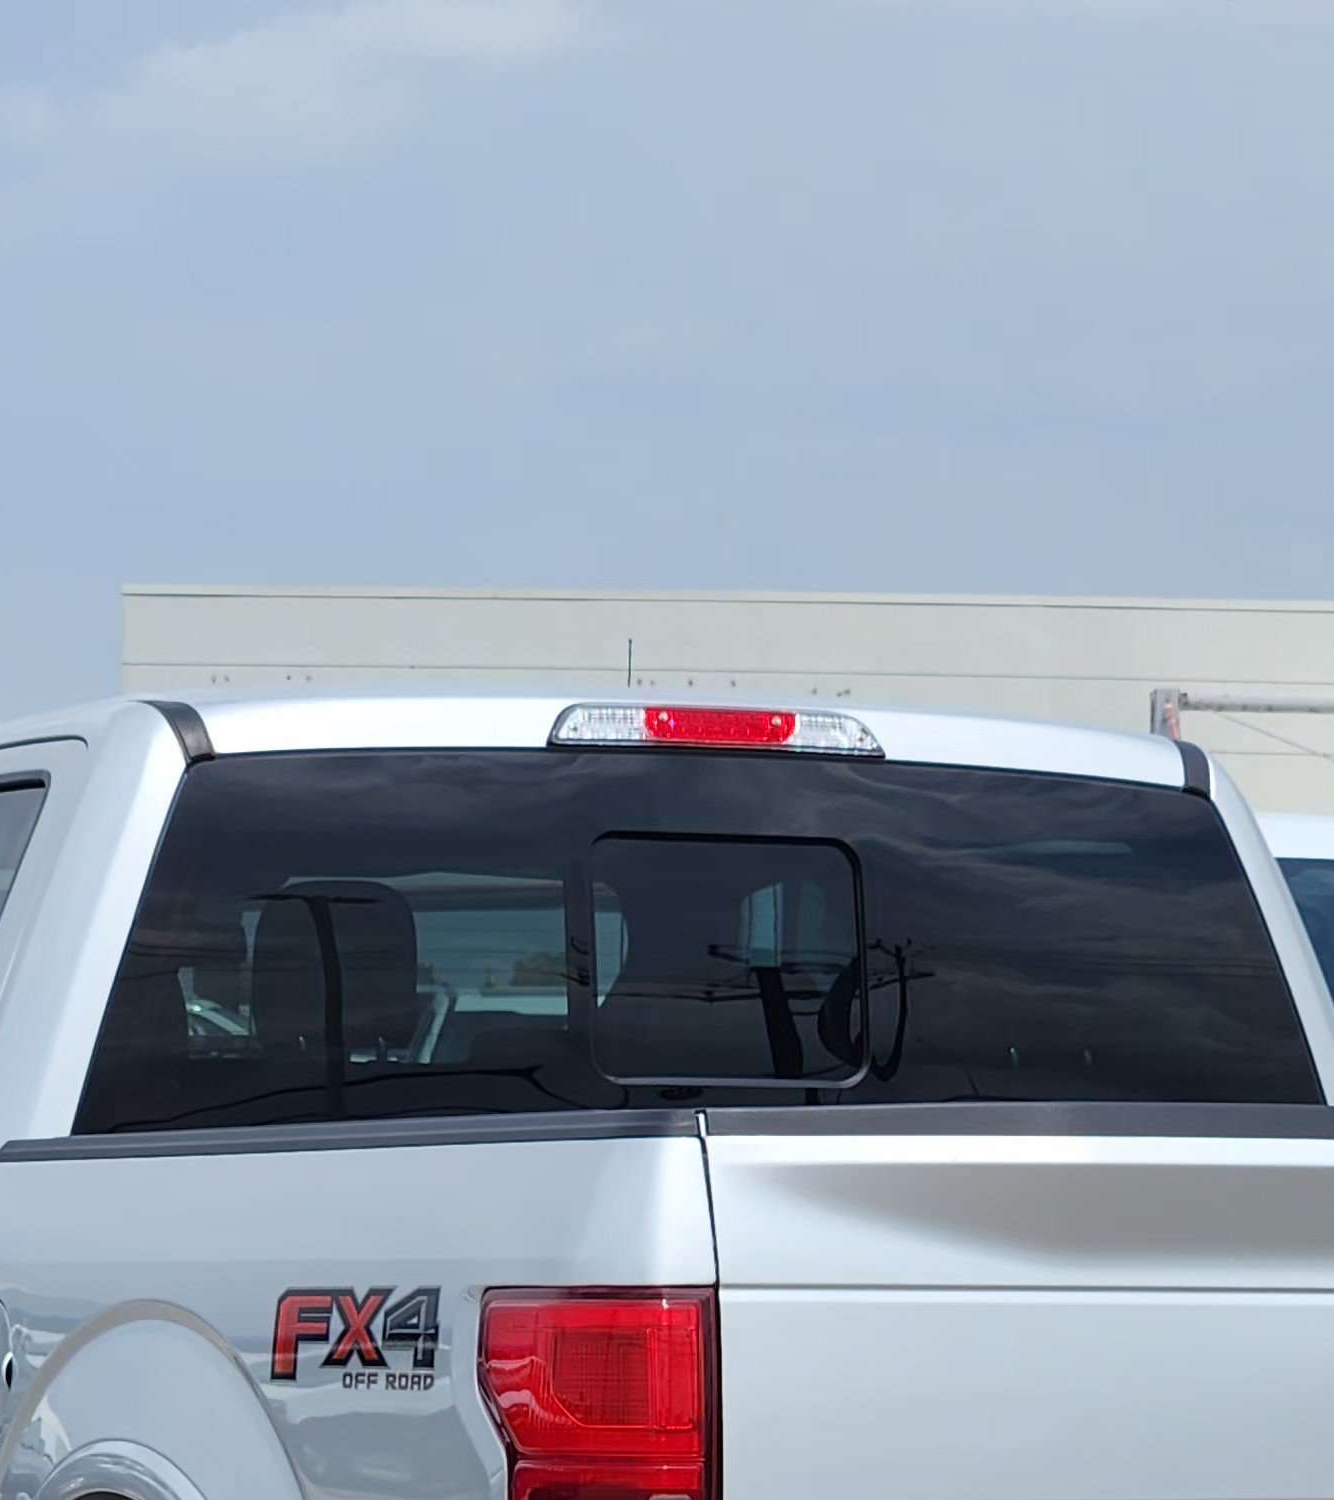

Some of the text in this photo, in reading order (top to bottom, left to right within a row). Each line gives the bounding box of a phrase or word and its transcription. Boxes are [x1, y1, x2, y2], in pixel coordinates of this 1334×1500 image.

[270, 1285, 441, 1382] FX4
[342, 1372, 435, 1390] OFF ROAD
